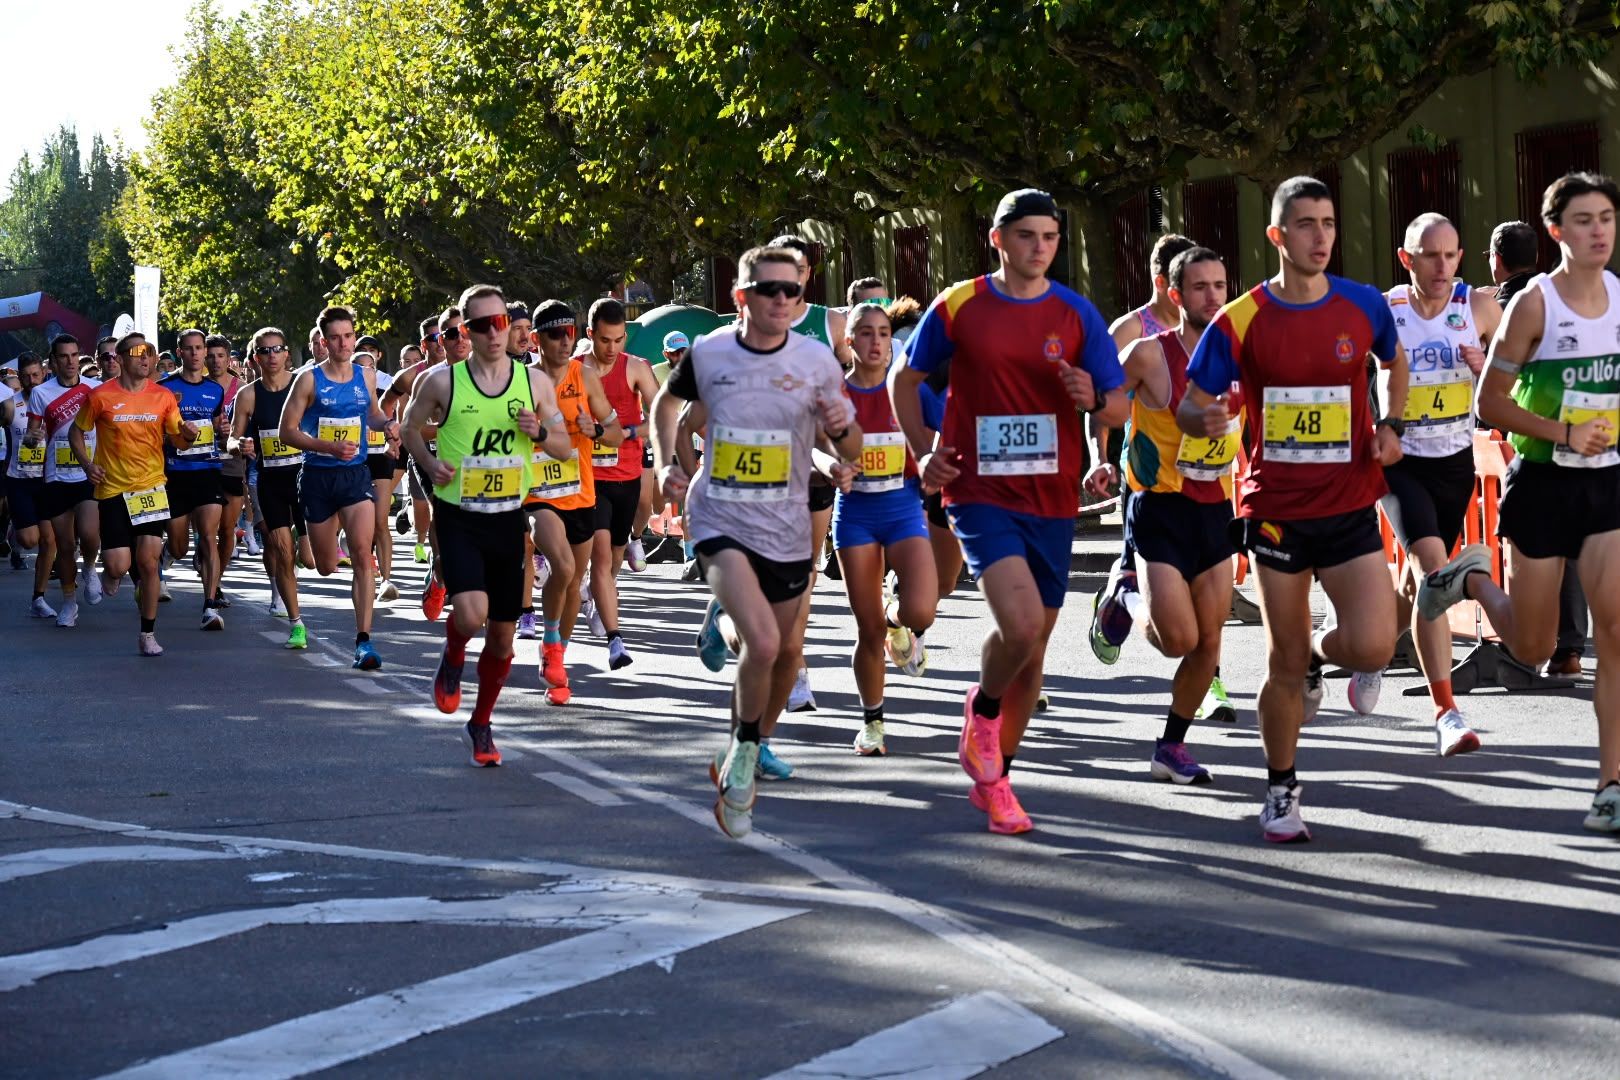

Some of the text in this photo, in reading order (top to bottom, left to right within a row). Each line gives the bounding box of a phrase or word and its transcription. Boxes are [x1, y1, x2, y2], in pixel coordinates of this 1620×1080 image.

[1404, 344, 1465, 370] regu
[1432, 390, 1445, 412] 4
[112, 412, 158, 423] ESPAÑA
[1293, 410, 1322, 435] 48
[470, 426, 516, 457] LRC
[998, 422, 1038, 447] 336
[1204, 438, 1227, 459] 24
[543, 463, 562, 481] 119
[735, 451, 763, 476] 45
[483, 473, 504, 493] 26
[139, 495, 156, 509] 98
